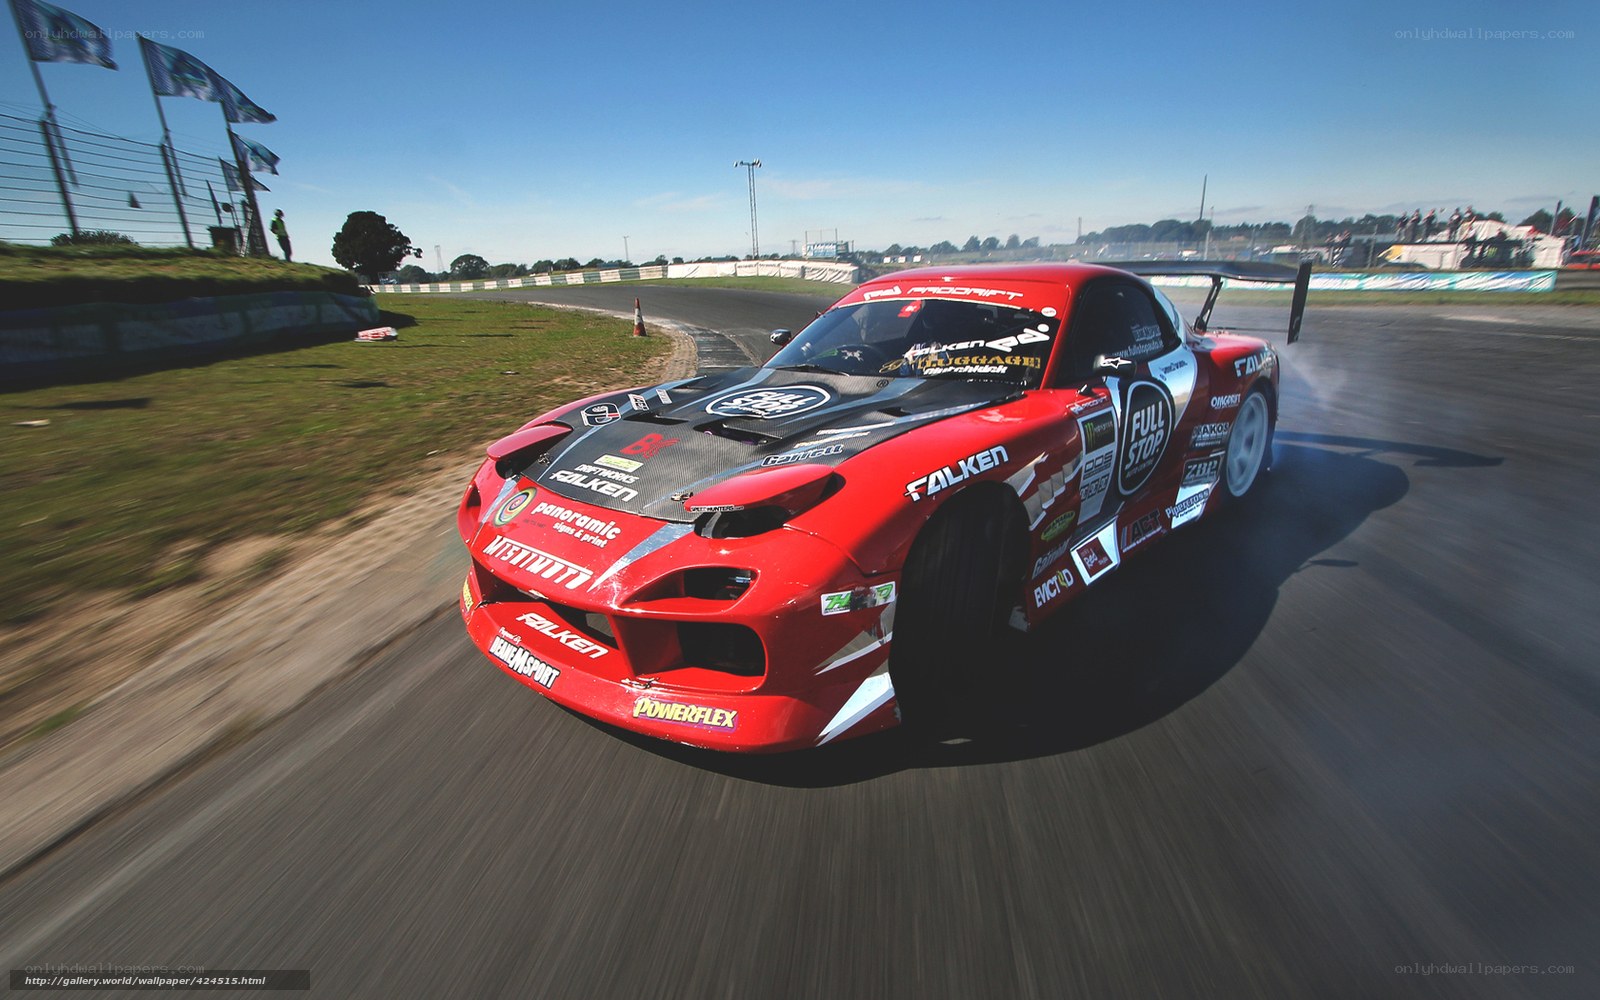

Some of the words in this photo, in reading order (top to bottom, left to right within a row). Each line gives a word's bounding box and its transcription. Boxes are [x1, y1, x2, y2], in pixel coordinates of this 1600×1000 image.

[1131, 400, 1165, 443] FULL
[761, 443, 844, 467] Garrett
[549, 469, 639, 502] FALKEN
[574, 463, 640, 484] DRIFTWORKS
[904, 445, 1009, 501] FALKEN
[1165, 488, 1211, 518] Pipercross
[531, 501, 621, 540] panoramic
[552, 521, 576, 535] signs
[574, 529, 585, 539] &
[580, 532, 608, 548] print
[515, 612, 608, 659] FALKEN
[633, 697, 738, 728] POWERFLEX
